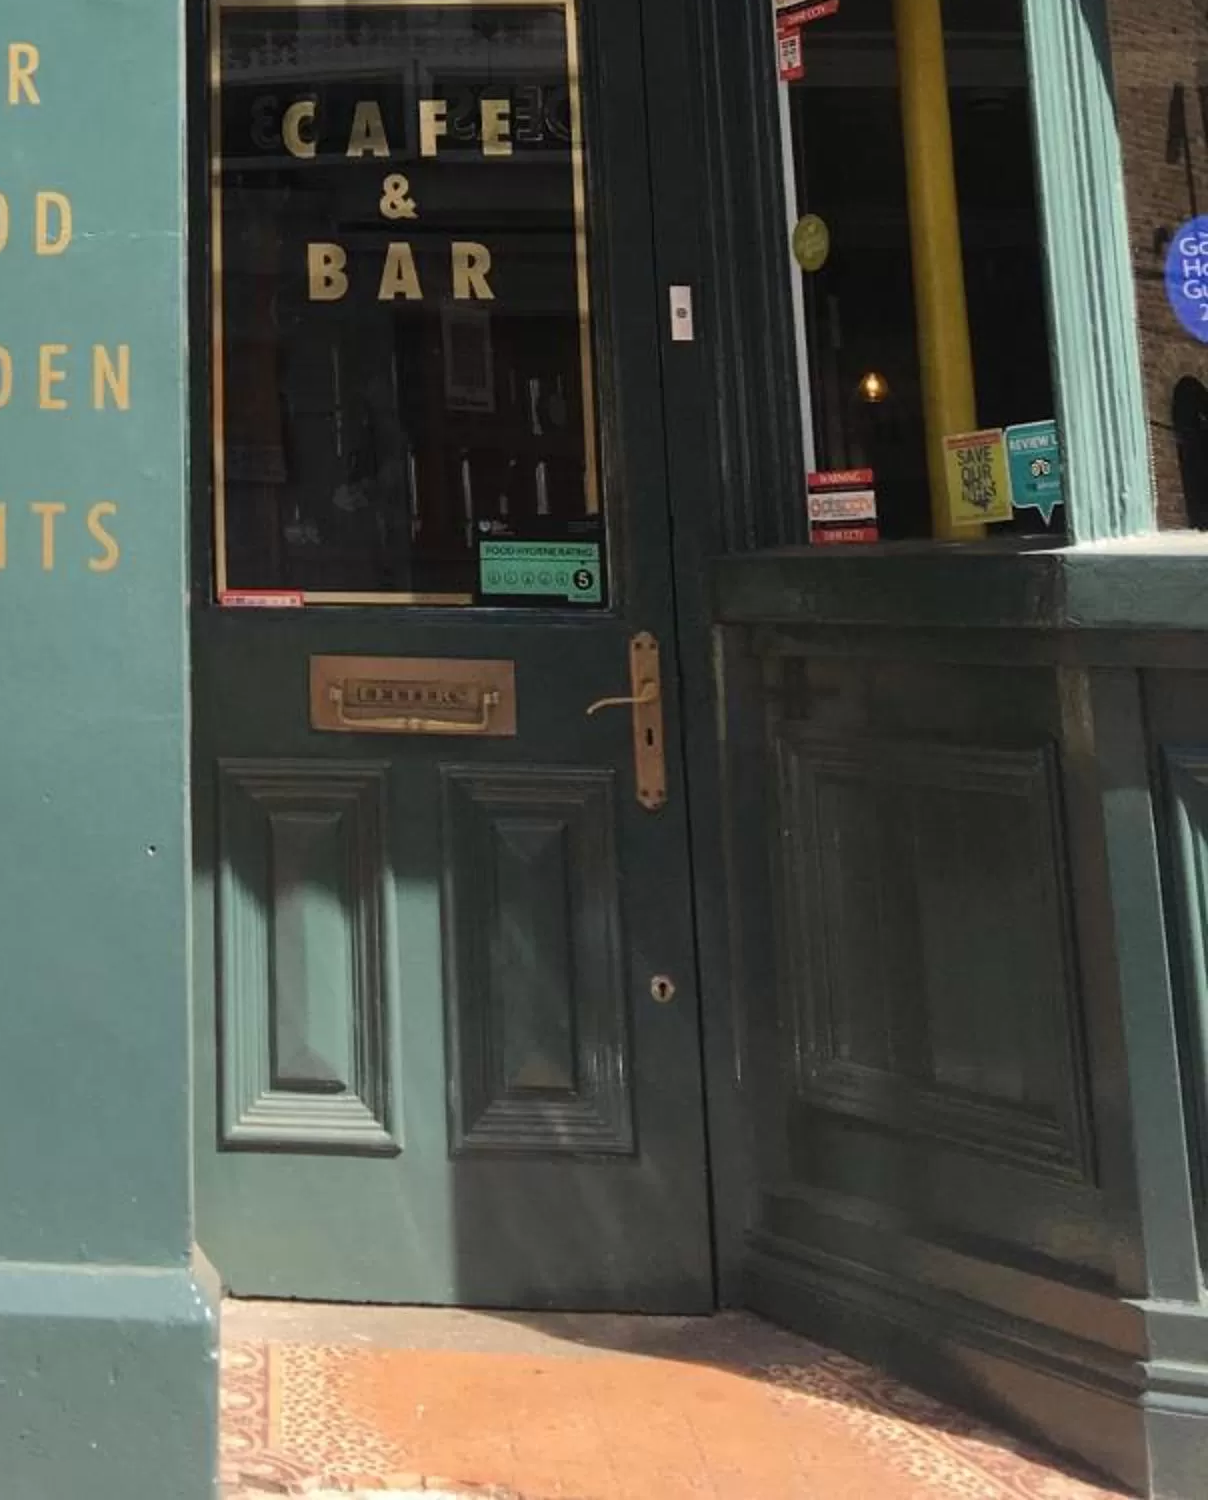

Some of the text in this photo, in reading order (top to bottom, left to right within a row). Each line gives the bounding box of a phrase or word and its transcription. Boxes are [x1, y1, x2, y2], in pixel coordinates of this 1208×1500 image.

[281, 100, 514, 159] CAFE
[379, 174, 419, 219] &
[307, 241, 495, 301] BAR
[956, 445, 994, 466] SAVE
